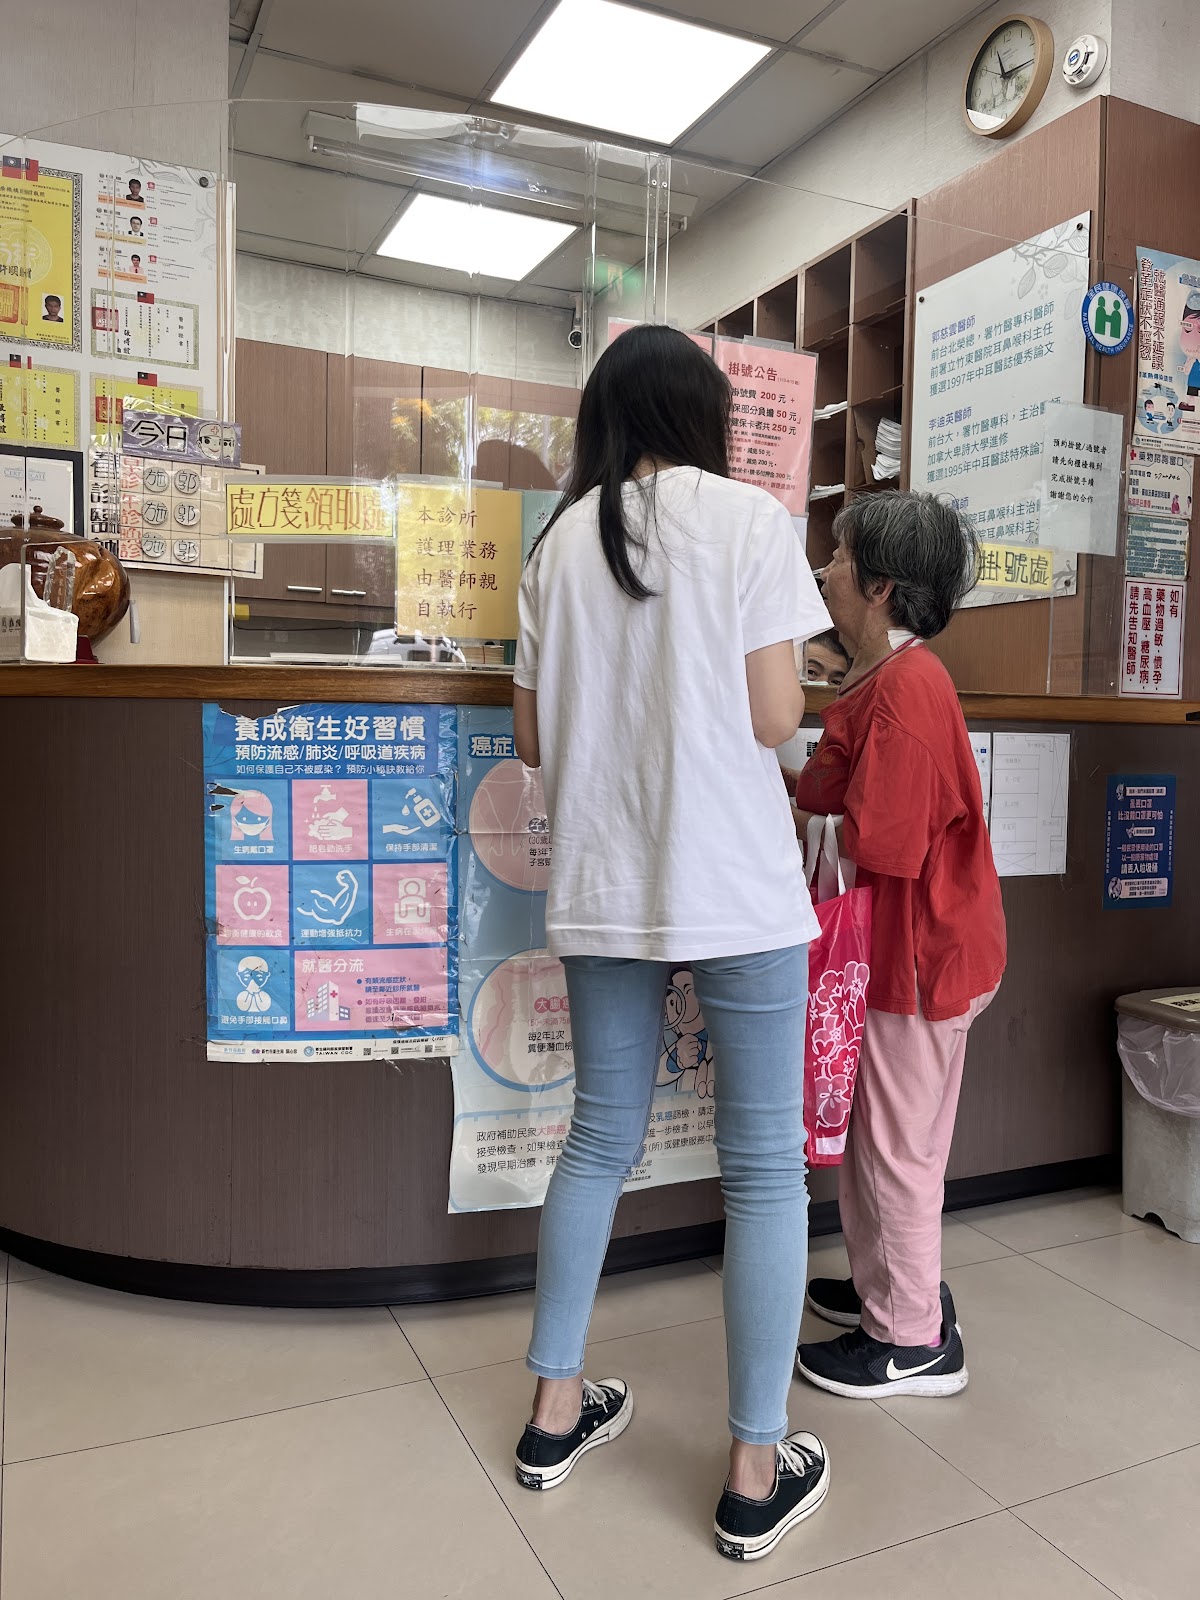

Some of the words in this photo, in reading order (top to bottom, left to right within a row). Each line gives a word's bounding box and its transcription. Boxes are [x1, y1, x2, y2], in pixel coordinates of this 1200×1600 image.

[728, 361, 777, 382] 掛號公告
[761, 392, 776, 401] 200
[778, 394, 786, 404] 元
[776, 410, 787, 418] 50
[131, 420, 186, 453] 今日
[772, 423, 787, 433] 250
[788, 426, 797, 436] 元
[927, 432, 1009, 466] 加拿大卑詩大學進修
[1050, 490, 1094, 503] 謝謝您的合作
[229, 486, 389, 532] 處方箋領取處
[417, 505, 478, 529] 本診所
[417, 537, 499, 561] 護理業務
[417, 568, 499, 591] 由醫師親
[417, 600, 478, 621] 自執行
[1169, 590, 1179, 618] 如有
[234, 715, 426, 742] 養成衛生好習慣
[235, 744, 426, 761] 預防流感/肺炎/呼吸道疾病
[471, 736, 519, 757] 癌症
[236, 764, 342, 775] 如何保護自己不被感染？
[385, 843, 438, 853] 保持手部清潔
[301, 928, 363, 938] 運動增強抵抗力
[301, 957, 364, 973] 就醫分流
[220, 1015, 288, 1025] 避免手部接觸口鼻
[528, 1030, 565, 1041] 每2年1次
